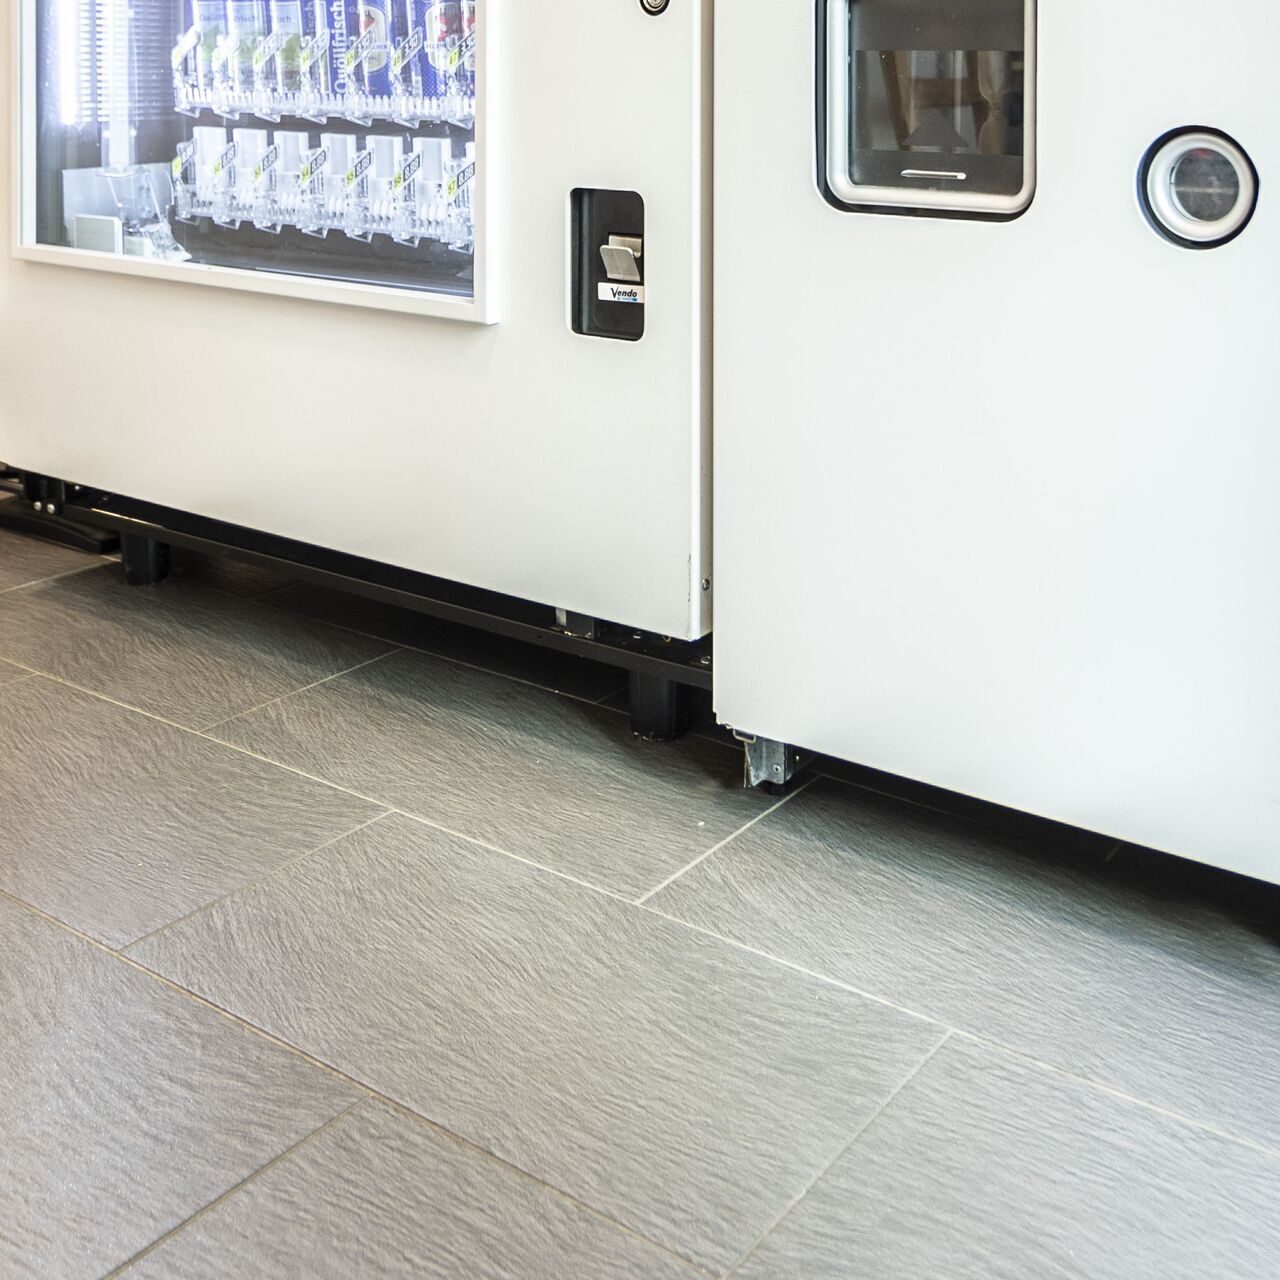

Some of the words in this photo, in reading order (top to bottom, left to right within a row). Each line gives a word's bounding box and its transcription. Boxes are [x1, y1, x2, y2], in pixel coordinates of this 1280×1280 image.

[330, 0, 346, 94] Quöllfrisch
[405, 157, 419, 179] 8.88
[459, 166, 474, 186] 8.88
[610, 285, 637, 298] Vendo
